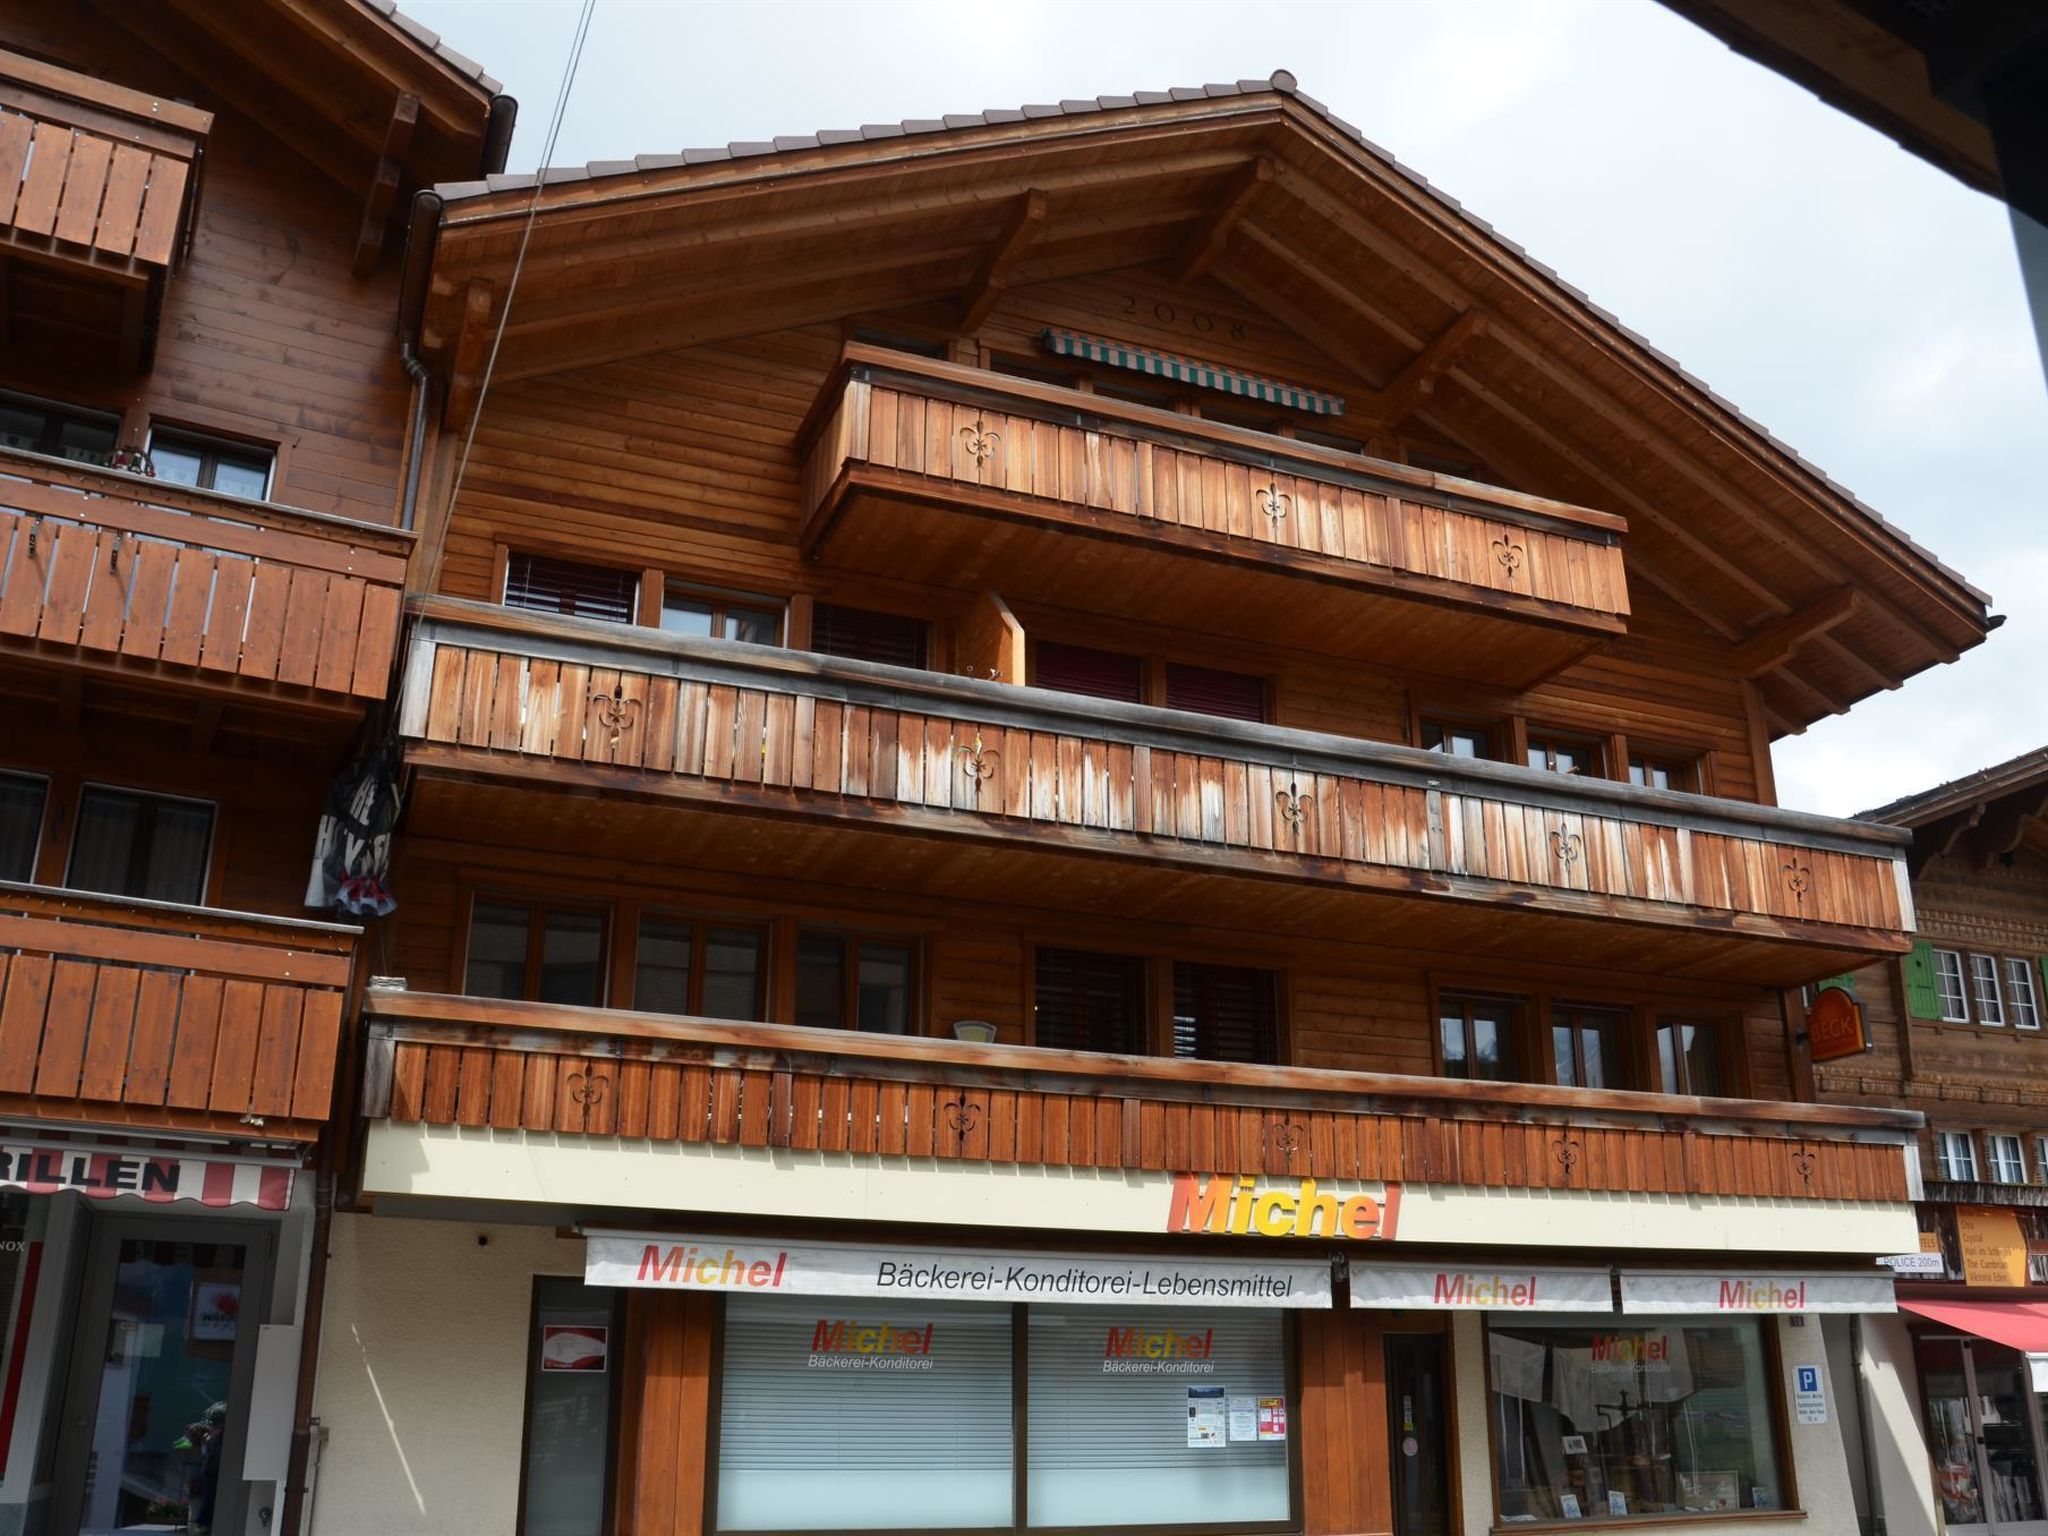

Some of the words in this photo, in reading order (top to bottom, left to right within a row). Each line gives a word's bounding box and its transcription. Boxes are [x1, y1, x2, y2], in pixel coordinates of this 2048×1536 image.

[1121, 295, 1247, 341] 2008
[1811, 1015, 1853, 1042] BECK
[1167, 1172, 1402, 1240] Michel
[1920, 1236, 1938, 1249] TELS
[637, 1244, 788, 1288] Michel
[876, 1261, 1293, 1298] Bäckerei-Konditorei-Lebensmittel
[1884, 1256, 1915, 1268] POLICE
[1434, 1273, 1536, 1306] Michel
[1719, 1280, 1805, 1310] Michel
[812, 1319, 934, 1355] Michel
[1105, 1326, 1213, 1359] Michel
[1591, 1333, 1669, 1361] Michel
[808, 1354, 933, 1370] Bäckerei-Konditorei
[1103, 1360, 1215, 1374] Bäckerei-Konditorei
[1803, 1371, 1813, 1390] P
